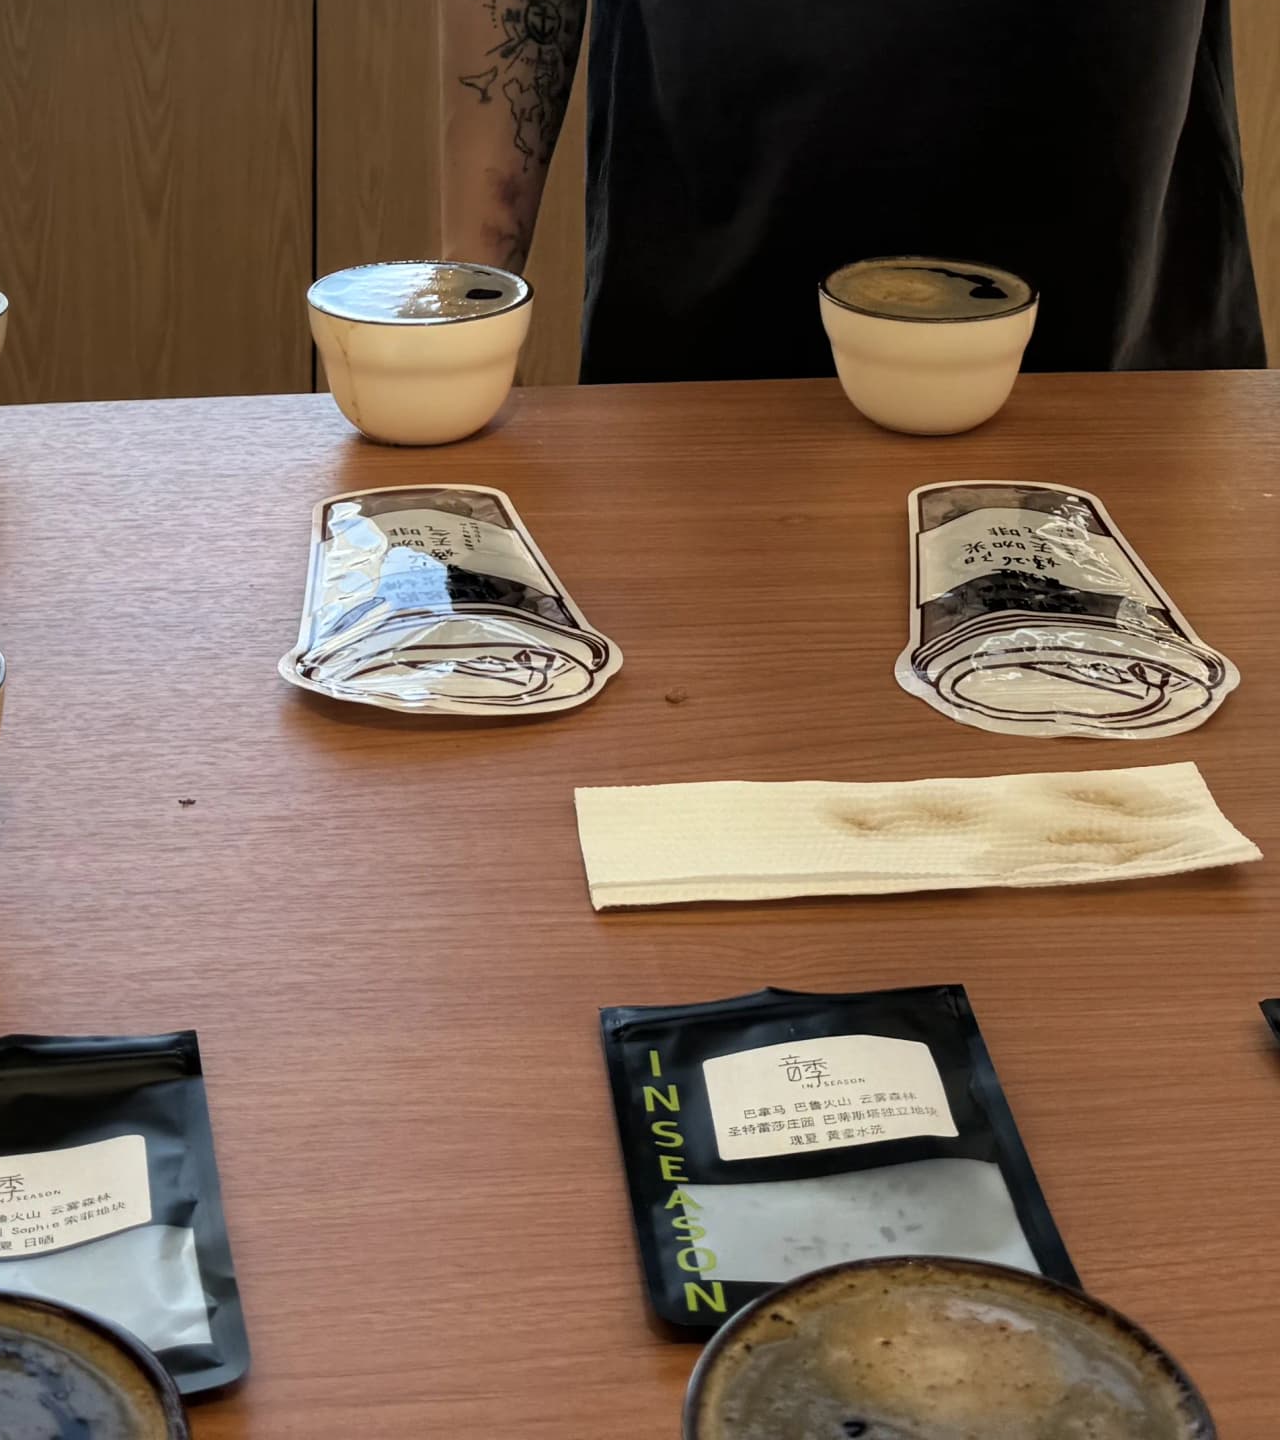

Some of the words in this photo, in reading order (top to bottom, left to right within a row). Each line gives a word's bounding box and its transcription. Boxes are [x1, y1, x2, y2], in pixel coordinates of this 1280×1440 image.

[823, 1077, 866, 1087] SEASON
[743, 1104, 787, 1119] 巴拿马
[794, 1096, 852, 1113] 巴鲁火山
[859, 1091, 918, 1105] 云雾森林
[728, 1116, 816, 1137] 圣特蕾莎庄园
[790, 1133, 819, 1146] 瑰夏
[643, 1049, 726, 1313] INSEASON
[16, 1189, 61, 1201] SEASON
[50, 1192, 112, 1216] 云雾森林
[11, 1221, 60, 1235] Sophie
[24, 1235, 55, 1248] 日晒
